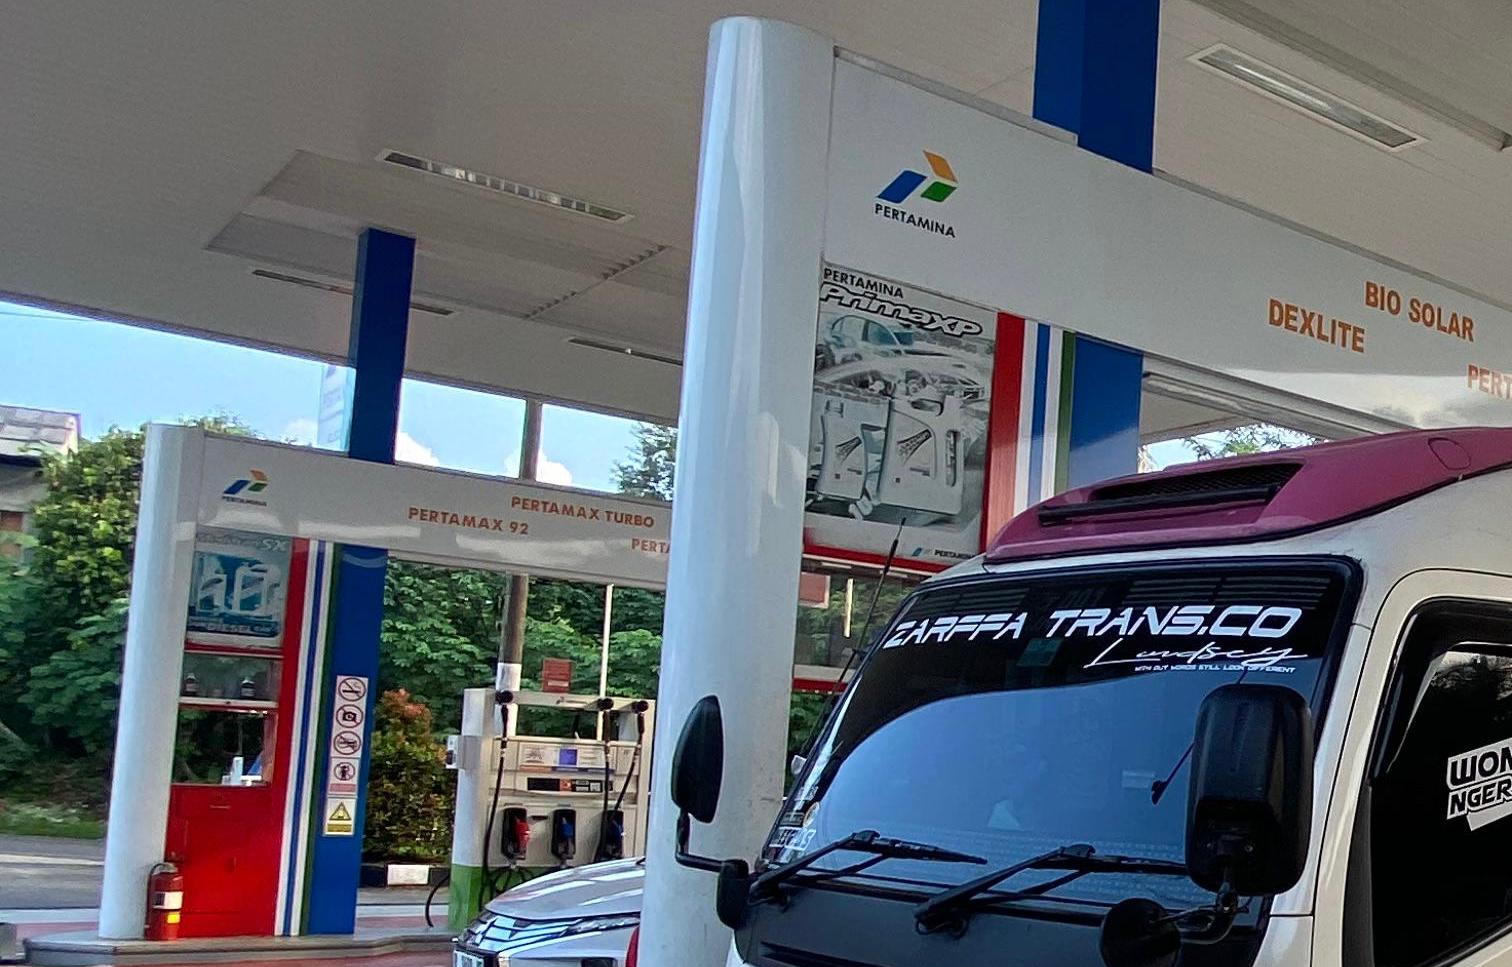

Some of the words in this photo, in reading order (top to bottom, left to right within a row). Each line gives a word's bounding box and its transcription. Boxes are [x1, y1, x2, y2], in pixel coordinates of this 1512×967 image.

[874, 203, 956, 239] PERTAMINA
[823, 267, 904, 299] PERTAMINA
[1268, 298, 1366, 353] DEXLITE
[1365, 281, 1401, 316] BIO
[1408, 298, 1475, 342] SOLAR
[408, 507, 503, 532] PERTAMAX
[509, 521, 529, 535] 92
[511, 496, 600, 521] PERTAMAX
[604, 510, 655, 529] TURBO
[883, 612, 1028, 650] ZARFFA
[1046, 604, 1303, 639] TRANS.CO
